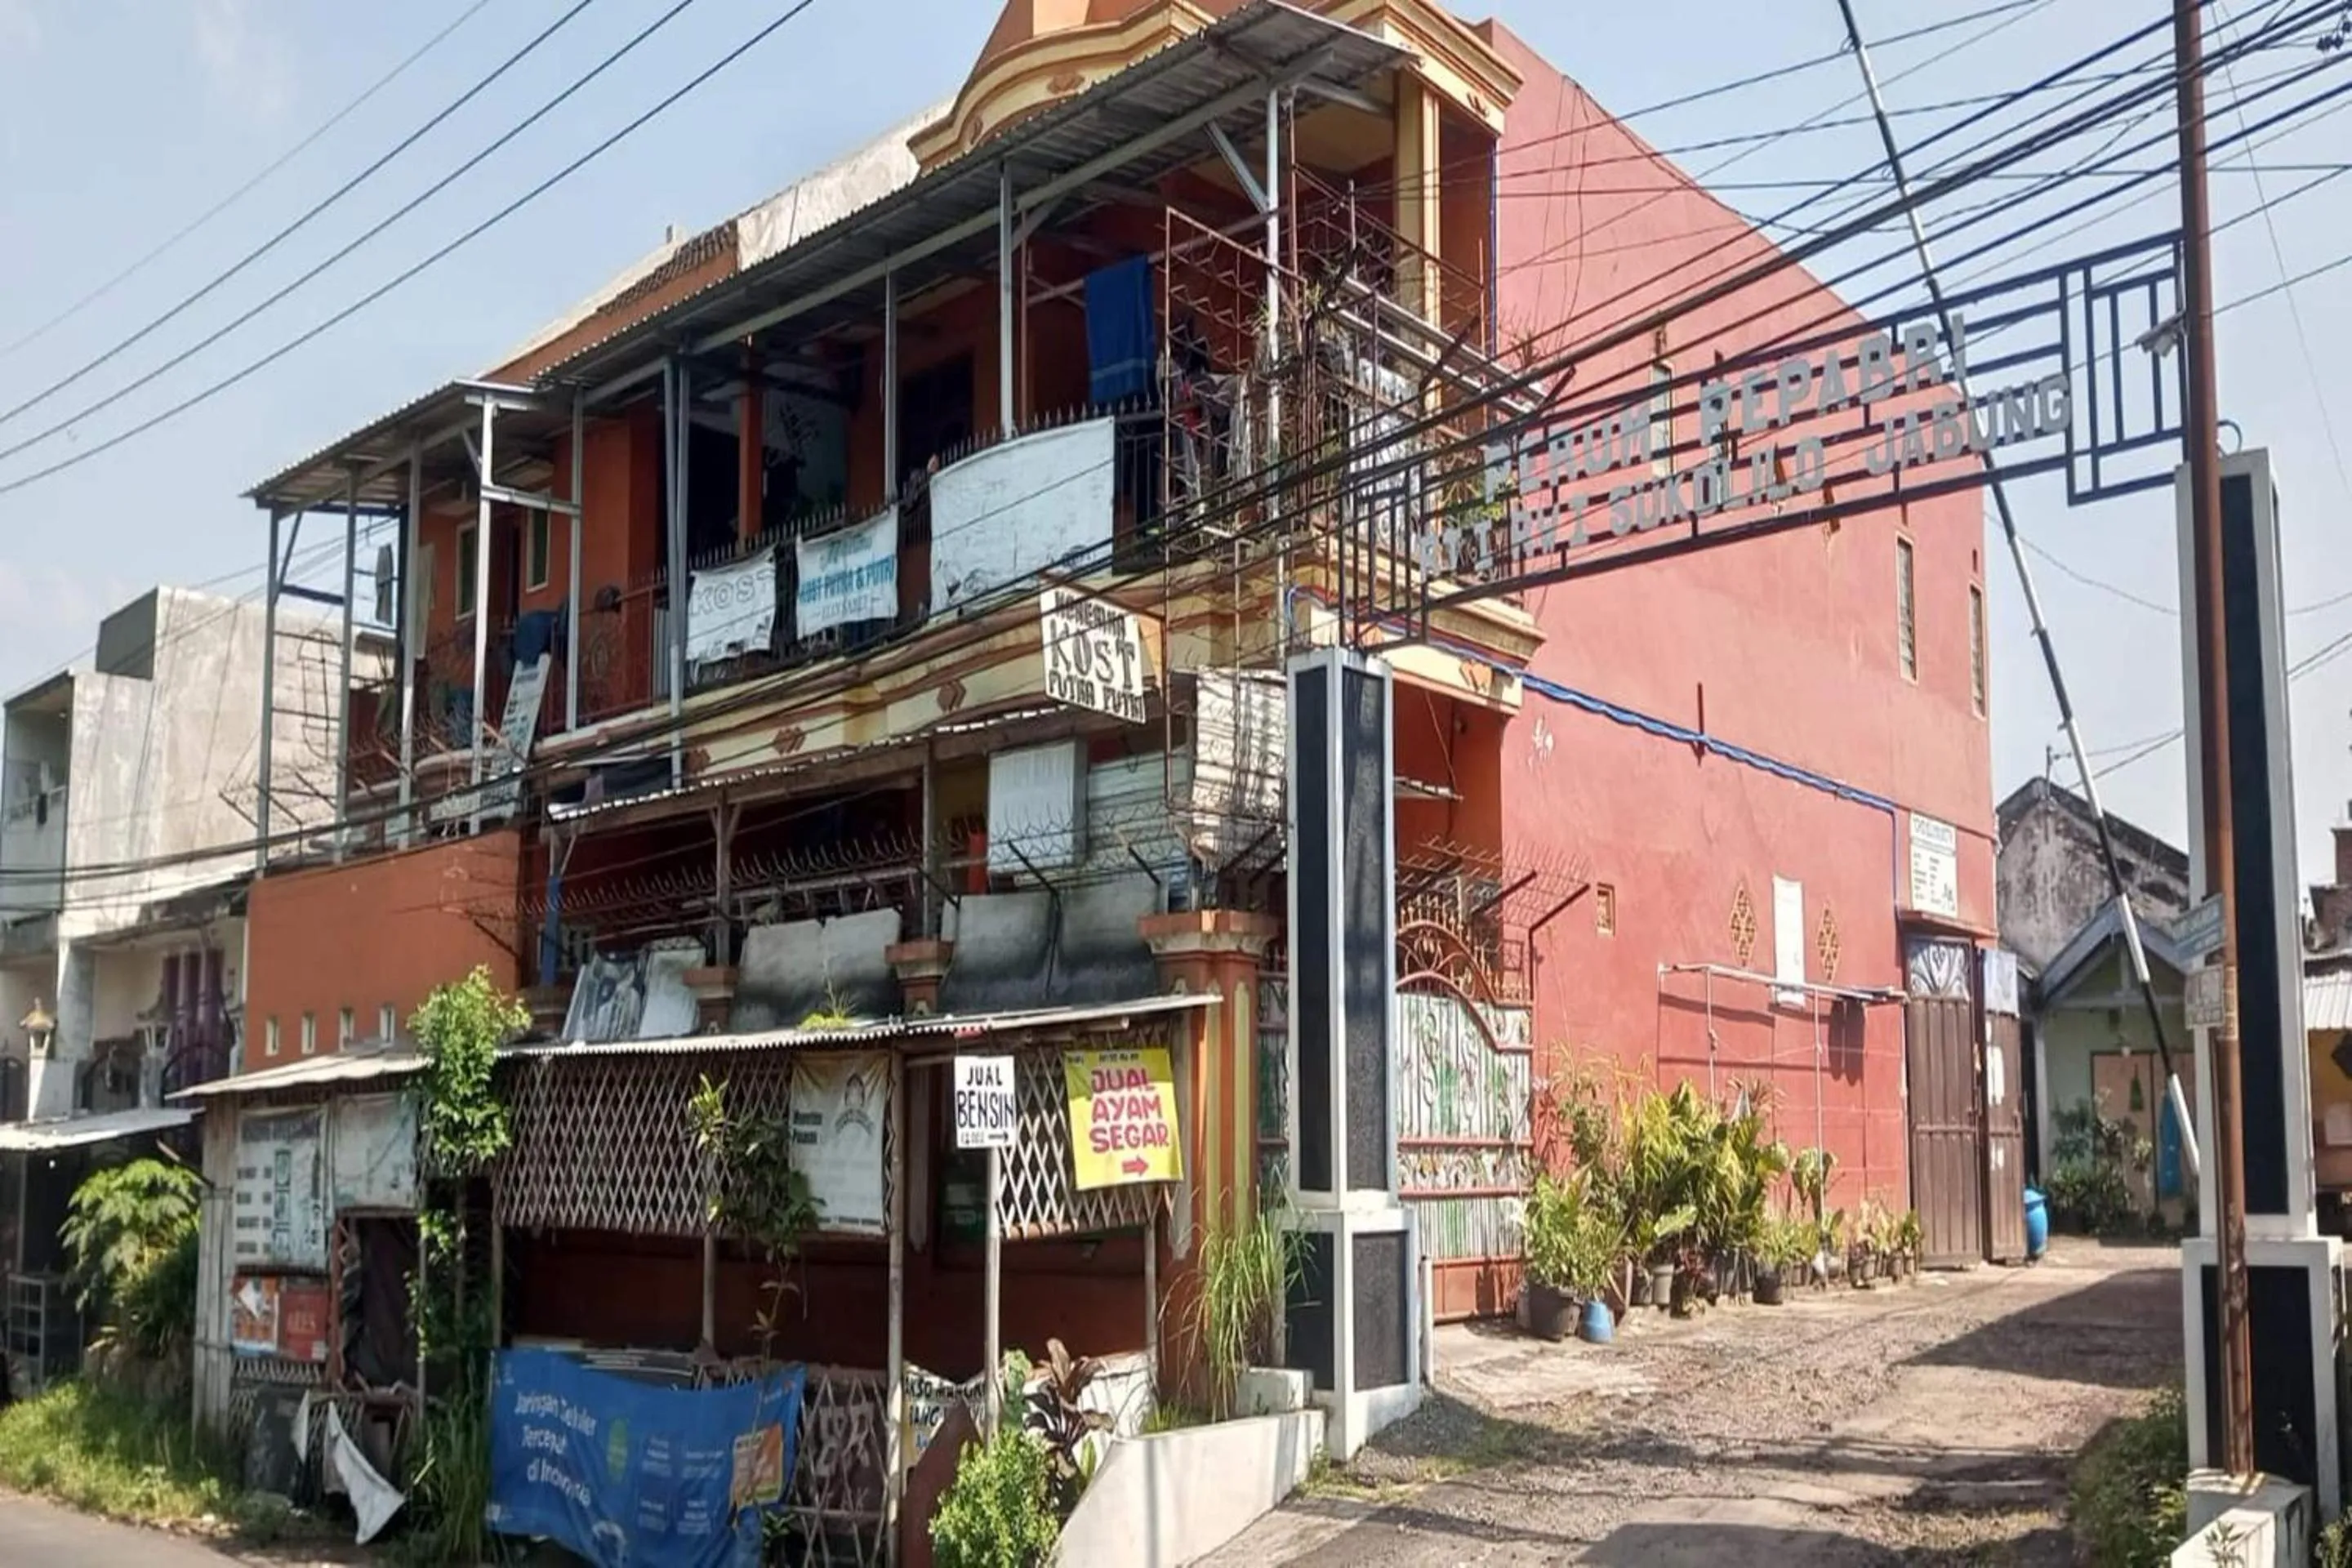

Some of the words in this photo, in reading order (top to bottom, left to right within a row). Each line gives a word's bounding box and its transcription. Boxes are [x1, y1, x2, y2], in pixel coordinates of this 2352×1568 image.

[1481, 406, 1652, 505] PERUM
[1699, 313, 1965, 448] PEPABRI
[1609, 435, 1826, 537] SUKOLILO
[1864, 372, 2072, 476] JABUNG
[1049, 618, 1136, 690] KOST
[1049, 670, 1096, 708] PUTRA
[966, 1064, 1003, 1087] JUAL
[1091, 1067, 1156, 1093] JUAL
[956, 1089, 1014, 1129] BENSIN
[1092, 1094, 1162, 1123] AYAM
[1089, 1122, 1169, 1154] SEGAR
